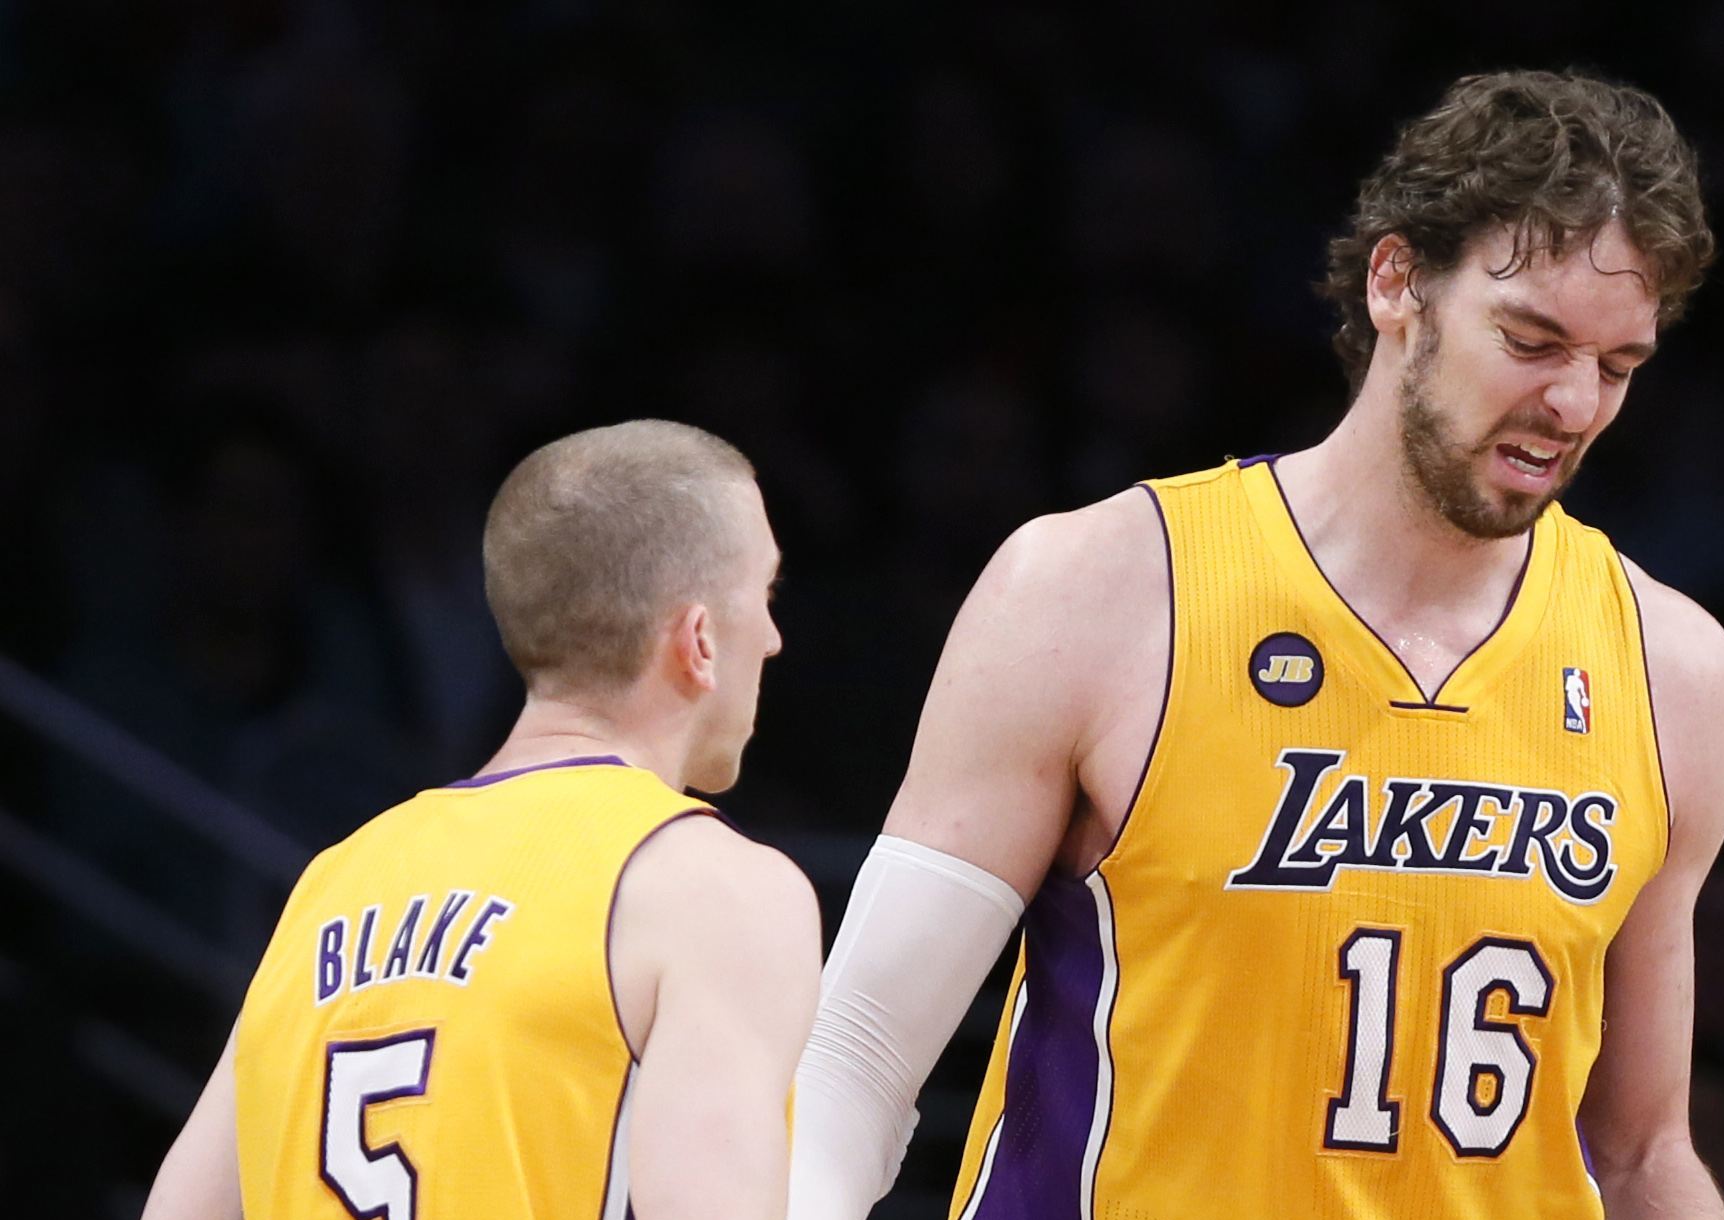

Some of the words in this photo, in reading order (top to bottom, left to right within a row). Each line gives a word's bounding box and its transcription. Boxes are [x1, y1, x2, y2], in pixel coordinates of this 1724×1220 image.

[1257, 655, 1315, 683] JB
[1224, 748, 1619, 905] LAKERS
[315, 889, 515, 1008] BLAKE
[1322, 927, 1555, 1158] 16
